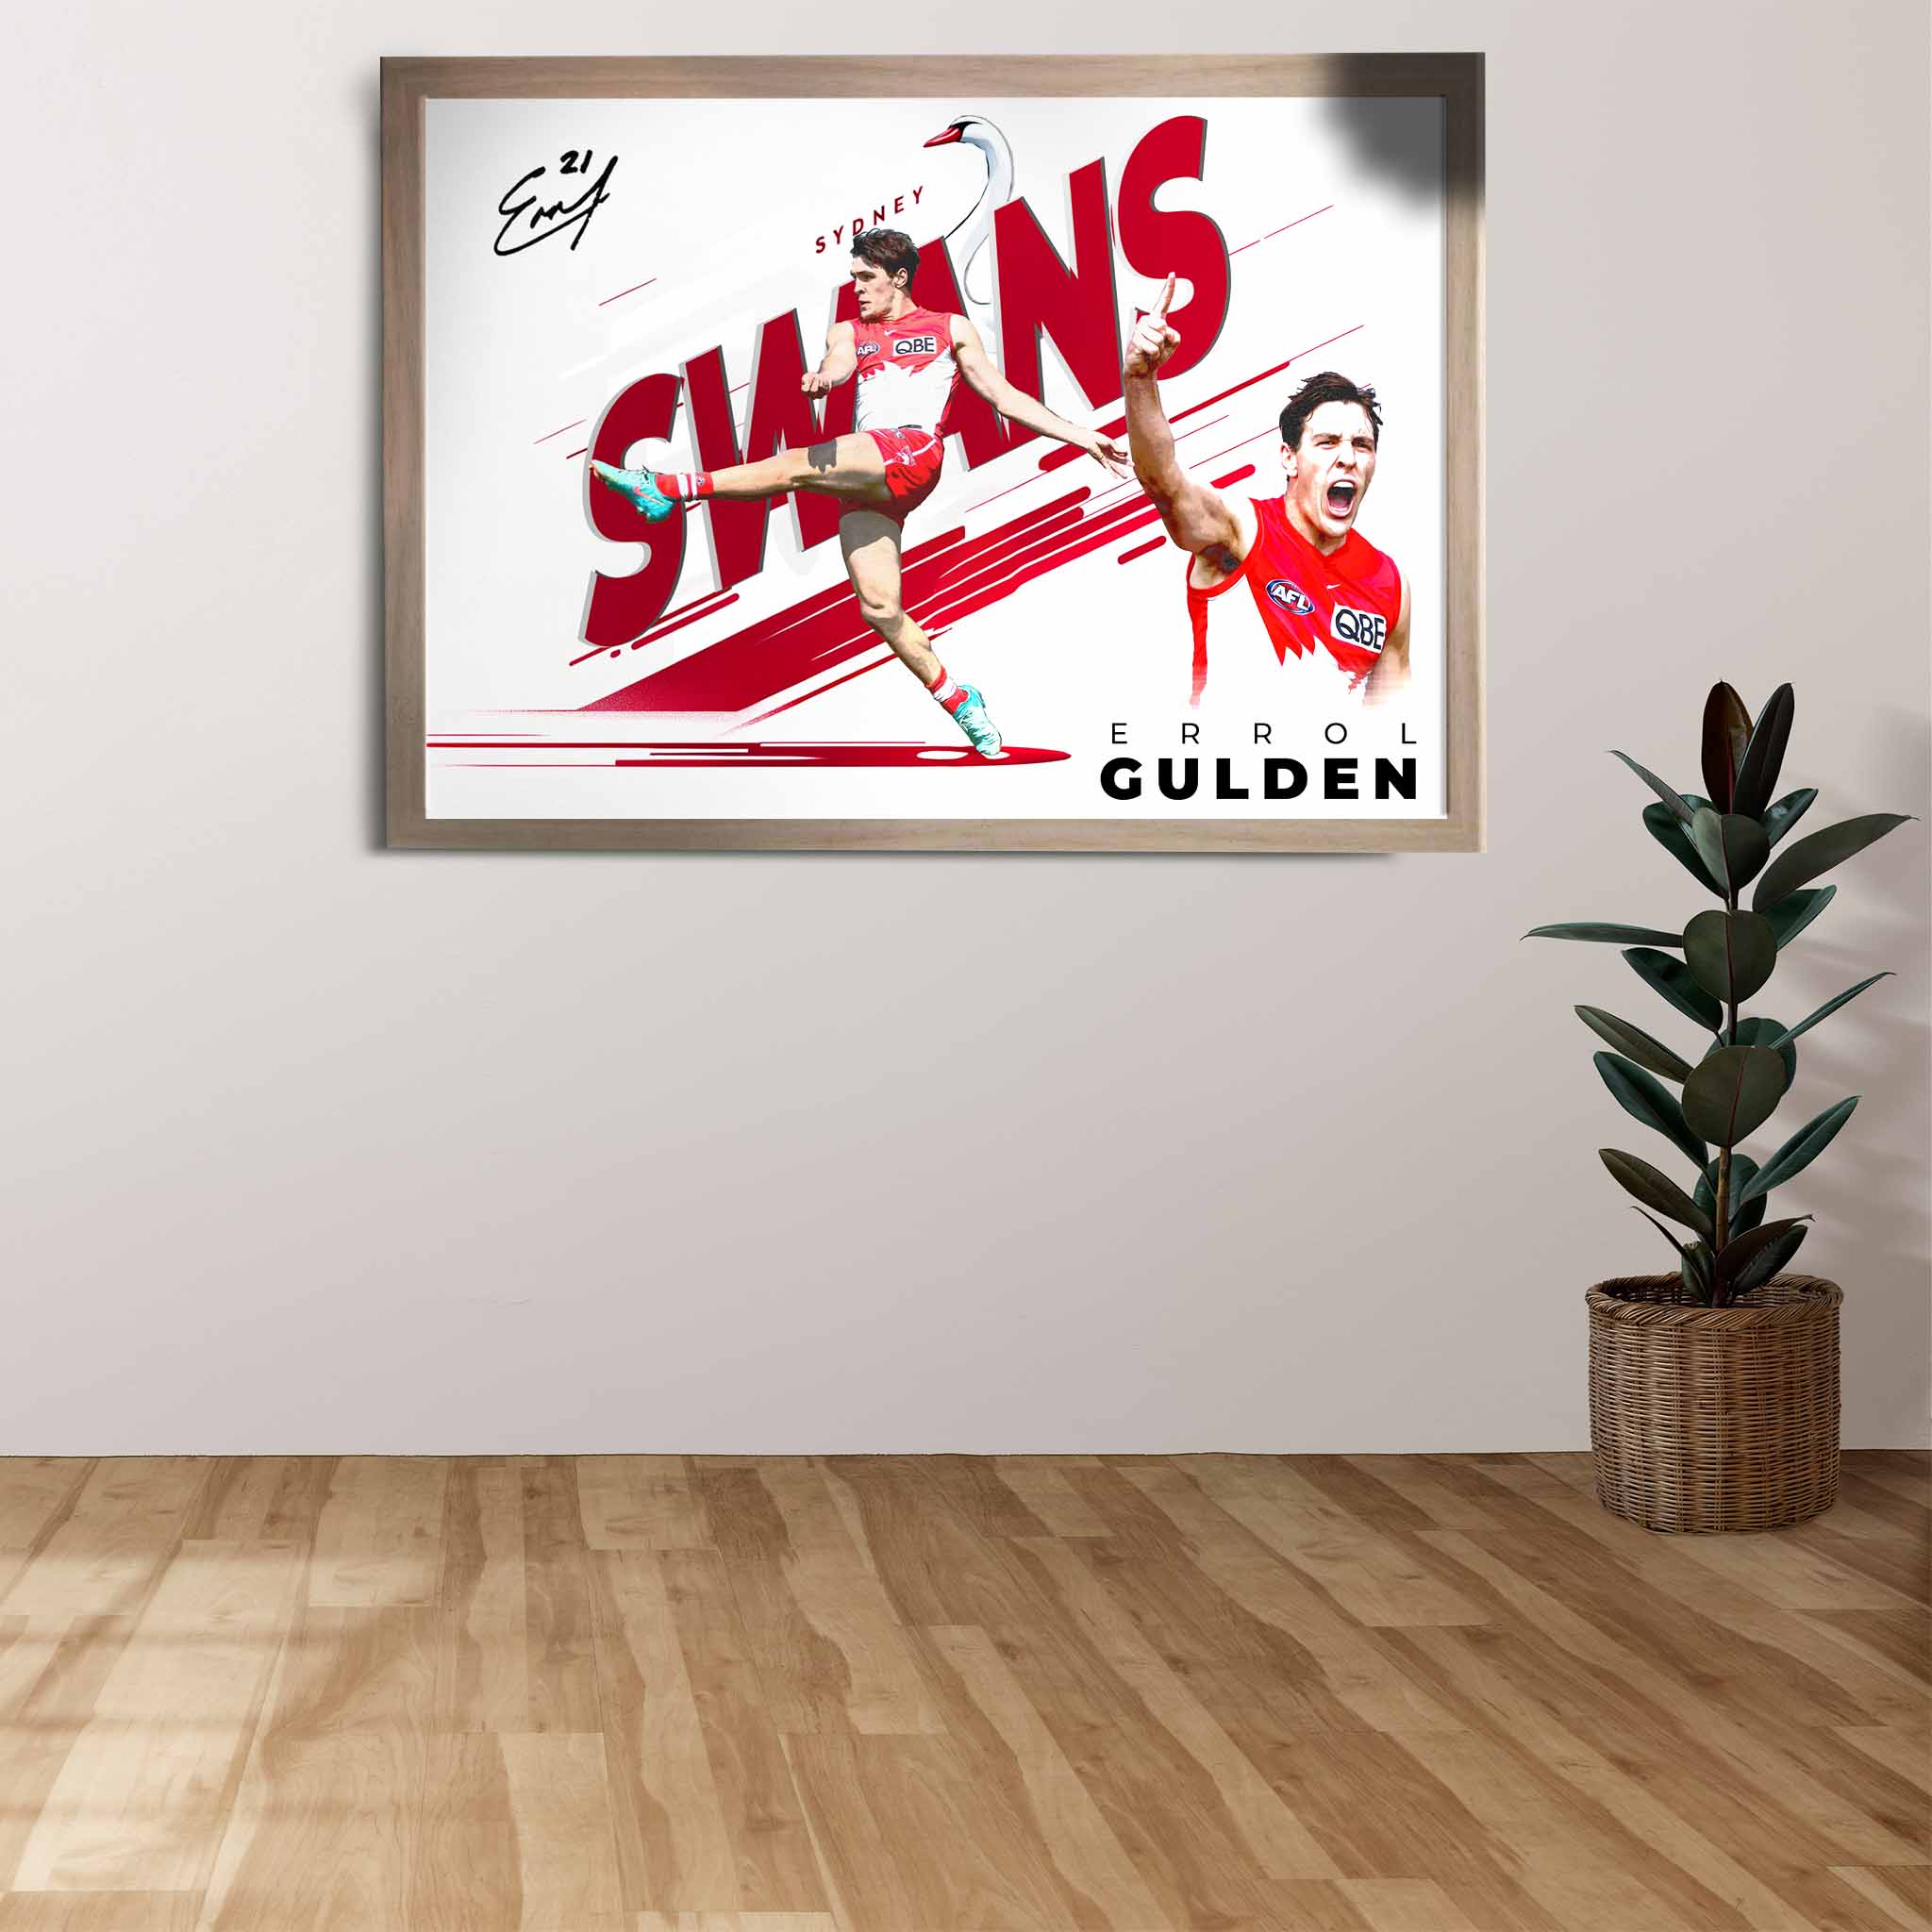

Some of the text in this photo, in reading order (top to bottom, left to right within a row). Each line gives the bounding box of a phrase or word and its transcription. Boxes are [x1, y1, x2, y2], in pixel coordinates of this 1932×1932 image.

[559, 149, 593, 175] 21
[815, 186, 924, 254] SYDNEY
[895, 338, 936, 355] QBE
[1272, 586, 1310, 611] AFL
[1336, 608, 1385, 650] QBE
[1111, 722, 1417, 745] ERROL
[1100, 757, 1417, 801] GULDEN
